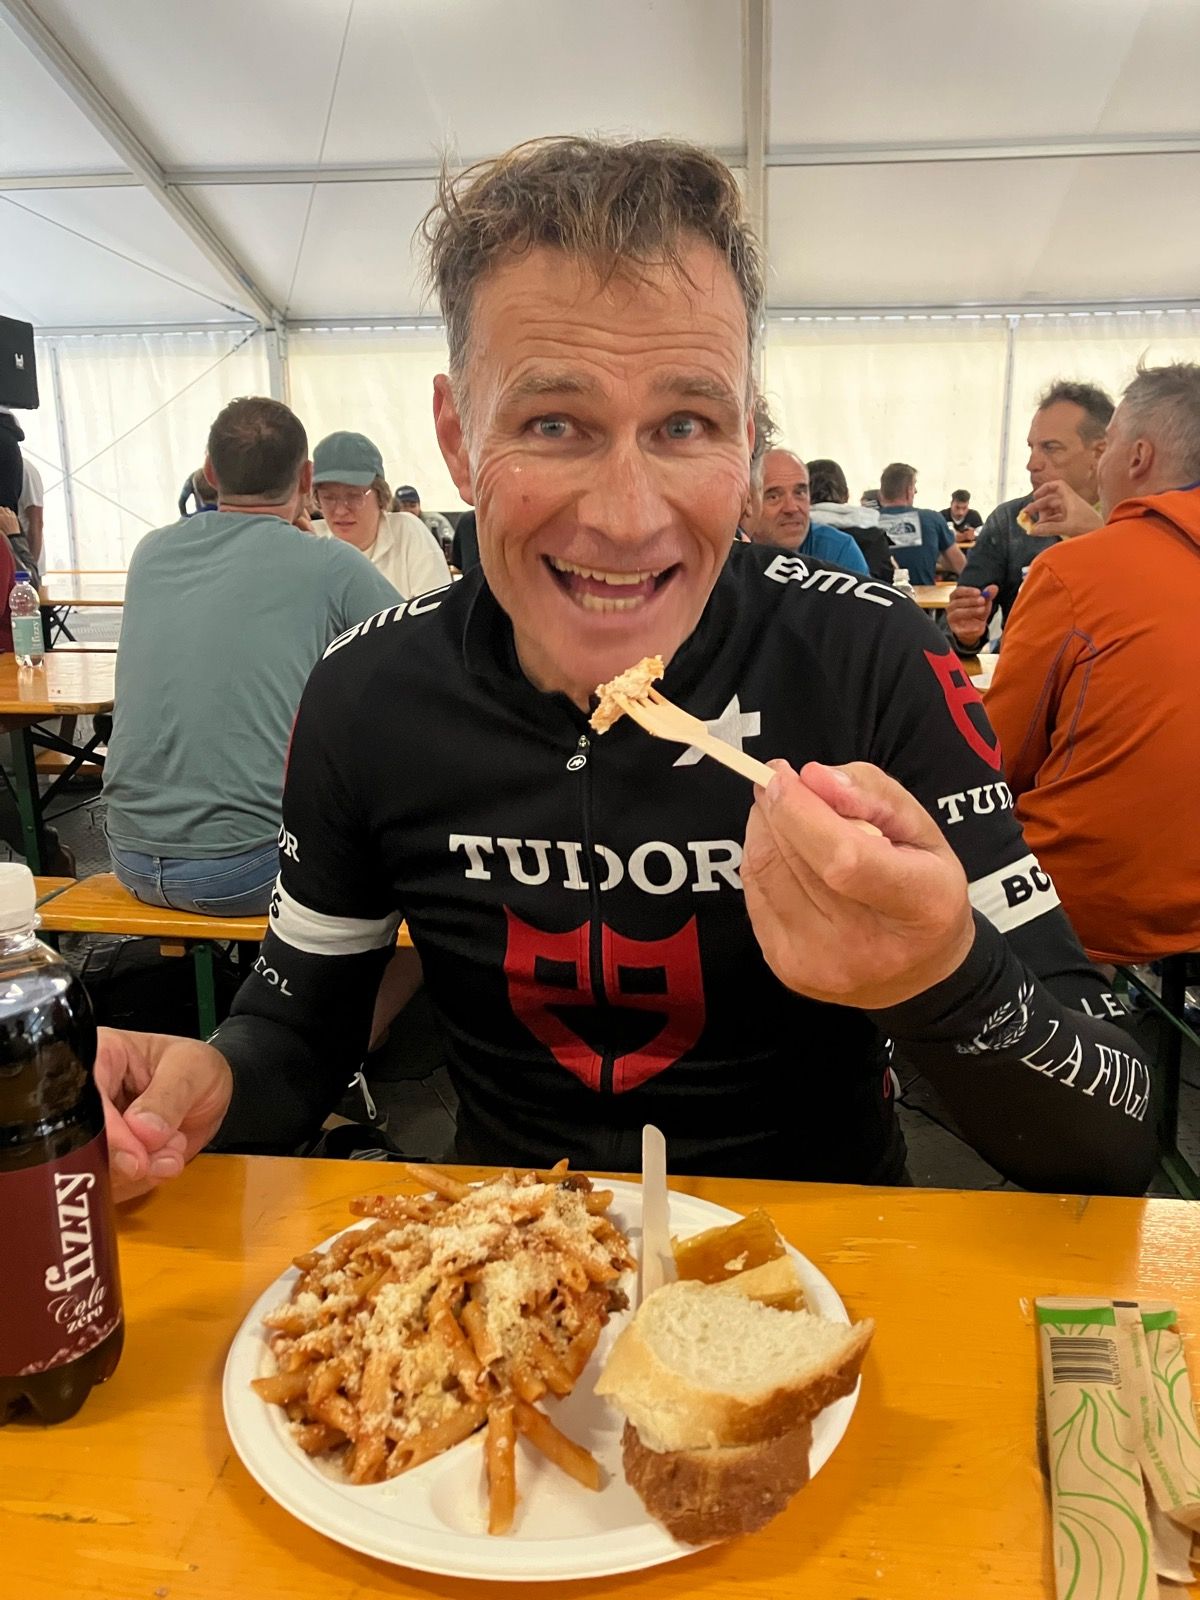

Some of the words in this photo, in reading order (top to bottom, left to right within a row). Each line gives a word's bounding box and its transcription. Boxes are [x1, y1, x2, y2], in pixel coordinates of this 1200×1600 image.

[764, 554, 907, 608] BMC
[448, 833, 743, 894] TUDOR
[45, 1172, 96, 1292] fizzy
[47, 1276, 108, 1324] Cola
